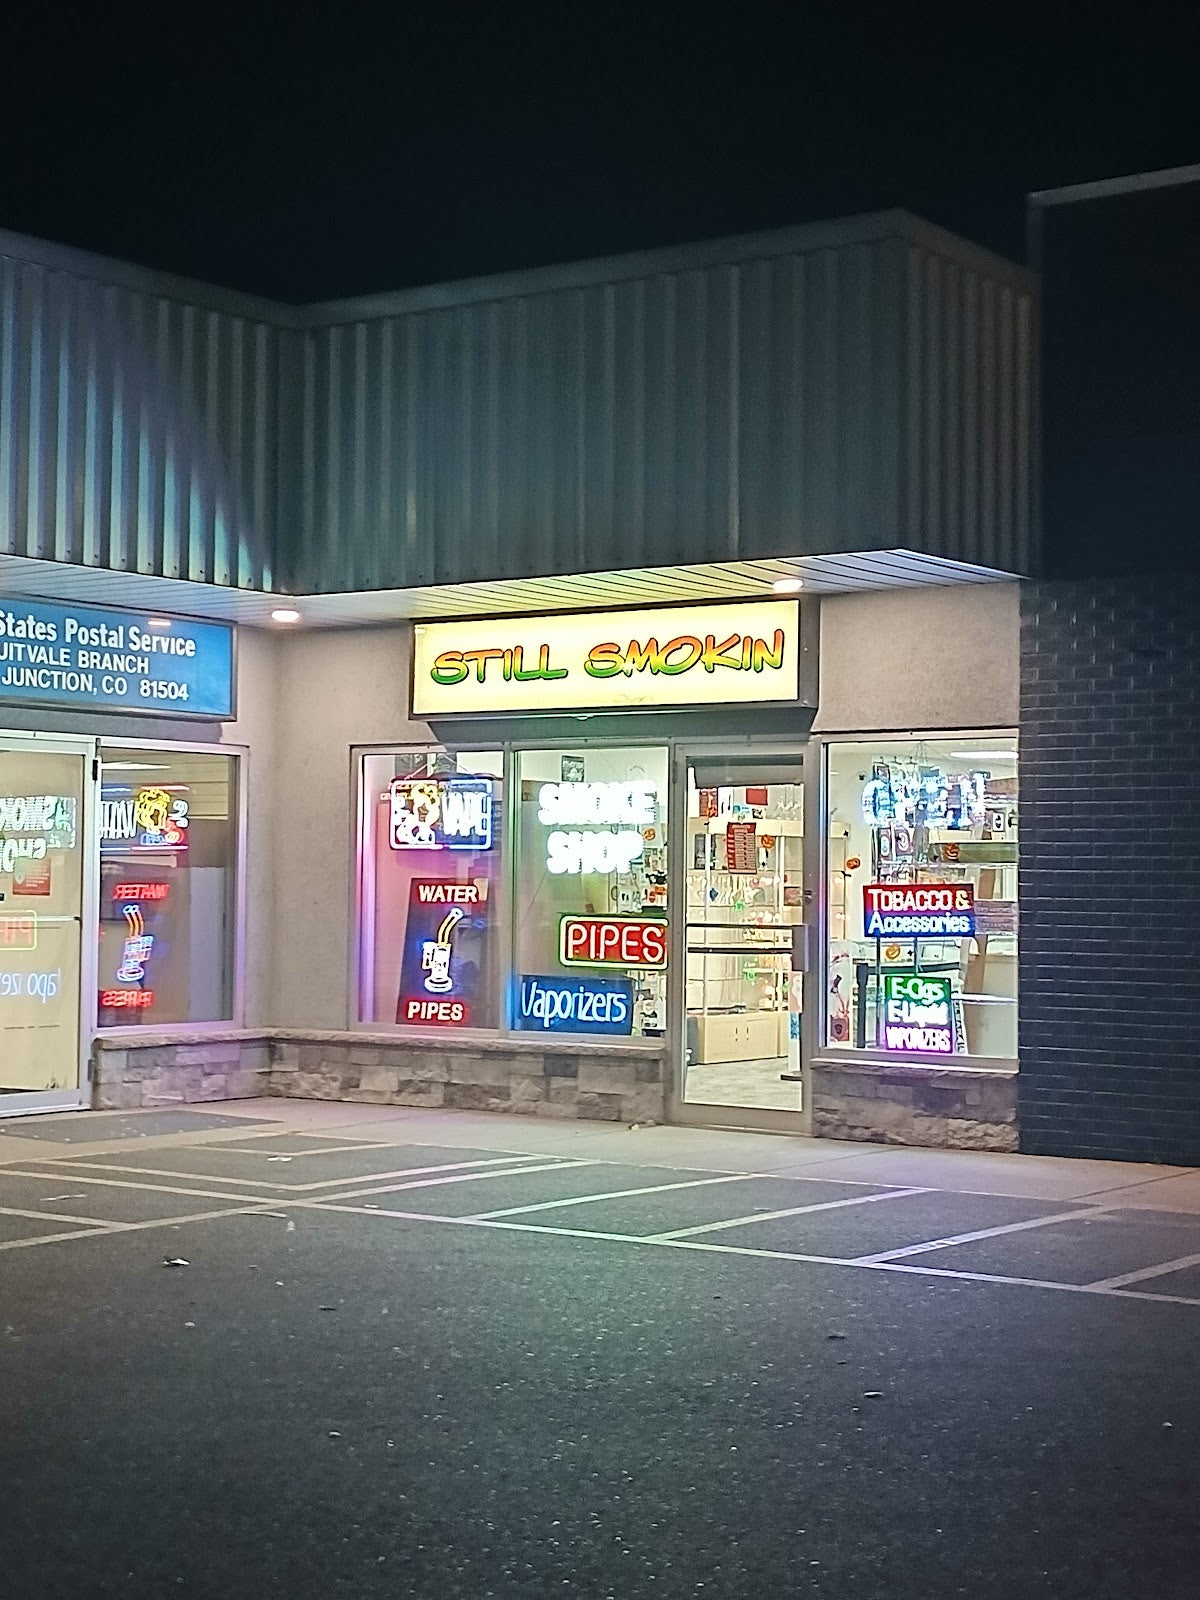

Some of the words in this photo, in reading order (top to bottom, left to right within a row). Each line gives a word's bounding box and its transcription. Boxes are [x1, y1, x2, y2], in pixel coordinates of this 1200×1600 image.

[0, 610, 57, 642] States
[65, 618, 124, 649] Postal
[129, 626, 196, 657] Service
[78, 650, 149, 674] BRANCH
[430, 644, 568, 686] STILL
[584, 628, 785, 680] SMOKIN
[2, 667, 97, 696] JUNCTION,
[102, 676, 127, 695] CO
[140, 679, 189, 701] 81504
[418, 884, 478, 902] WATER
[867, 888, 953, 911] TOBACCO
[955, 889, 971, 910] &
[867, 911, 971, 934] Accessories
[567, 923, 664, 962] PIPES
[407, 1002, 463, 1021] PIPES
[521, 981, 627, 1028] Vaporizers
